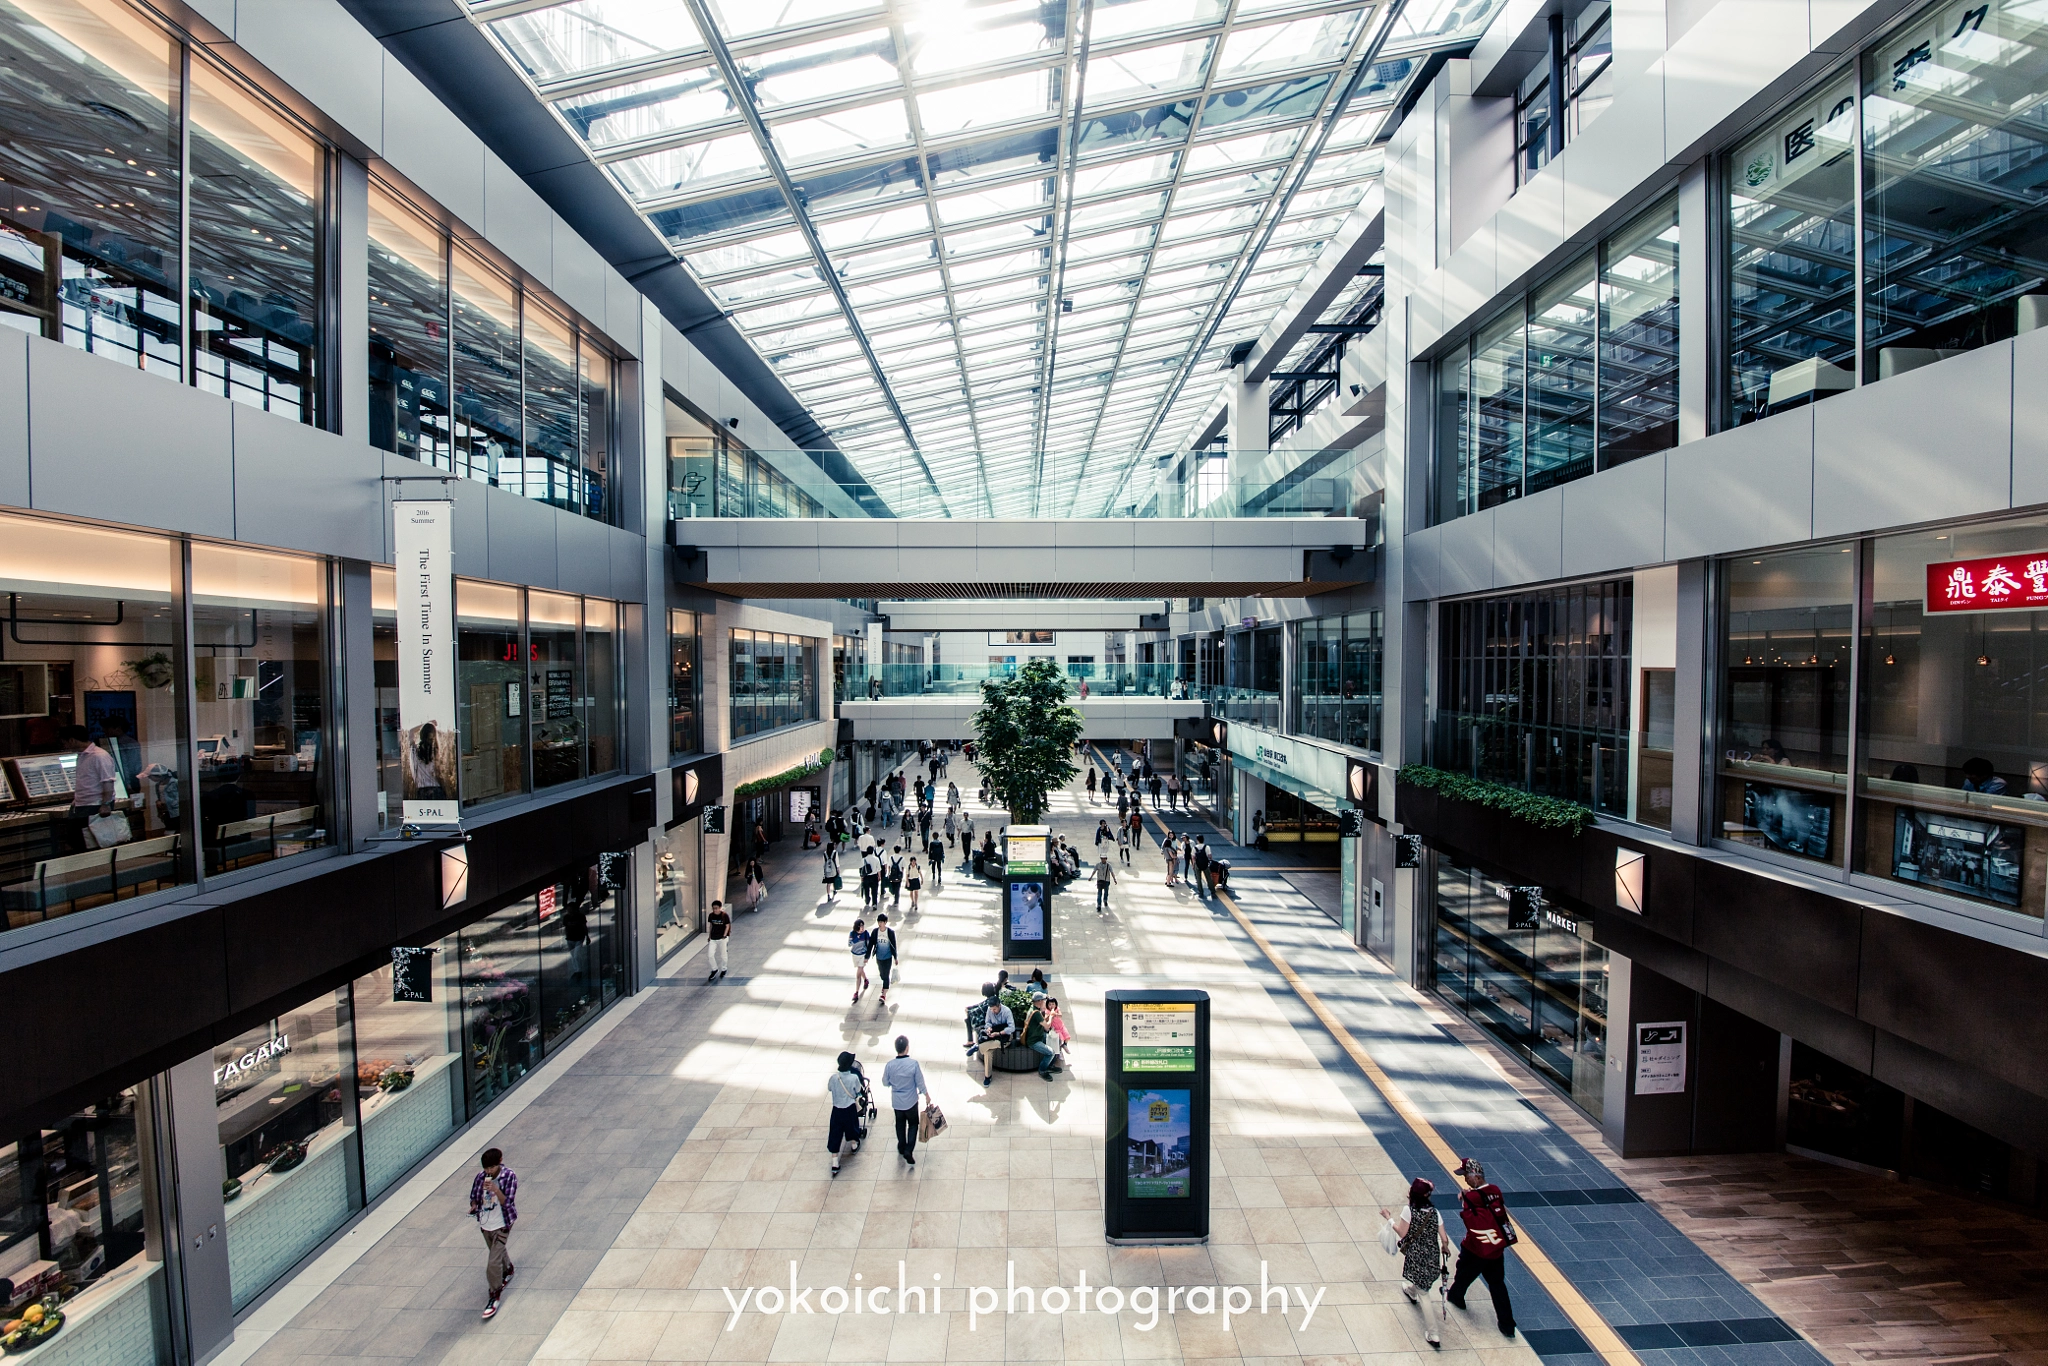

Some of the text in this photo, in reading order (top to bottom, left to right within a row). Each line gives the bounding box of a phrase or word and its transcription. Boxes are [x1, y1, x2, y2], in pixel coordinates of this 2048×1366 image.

[419, 548, 433, 695] The First Time In Summer
[1546, 910, 1577, 933] MARKET
